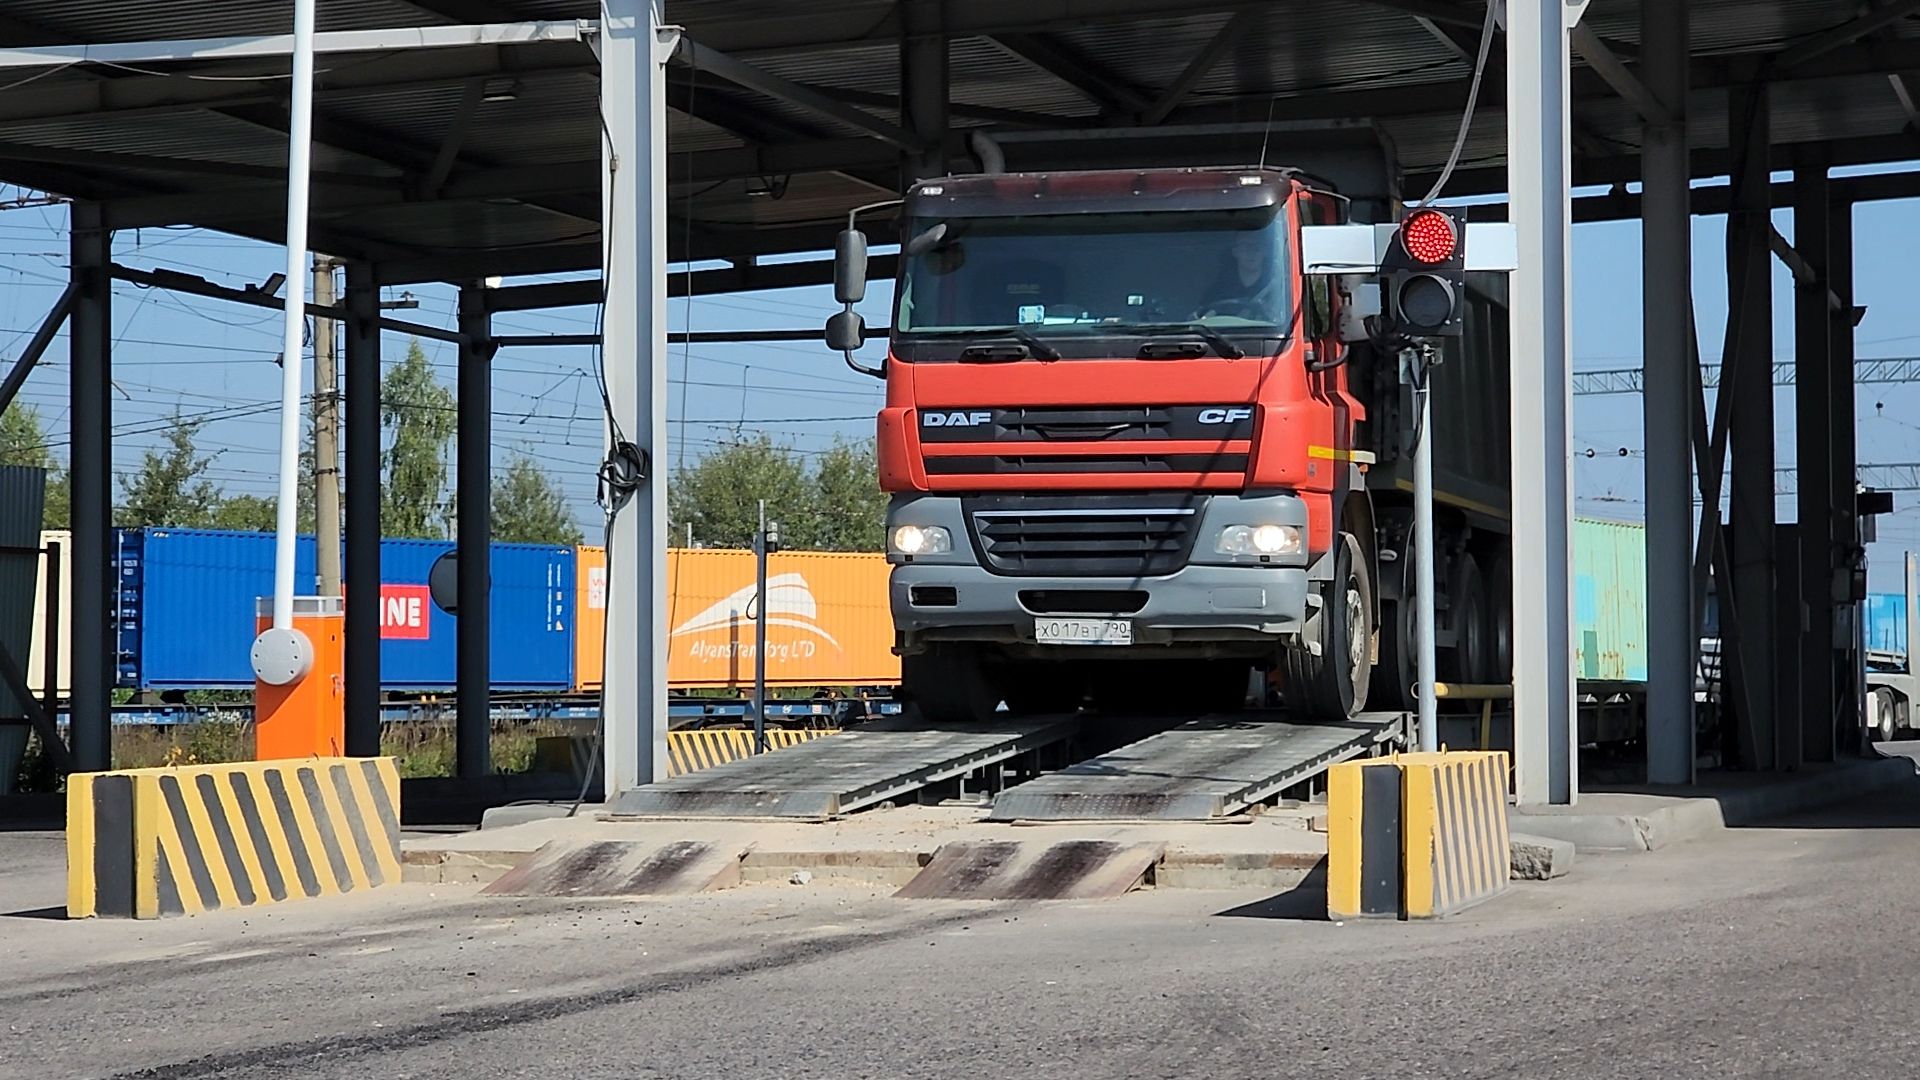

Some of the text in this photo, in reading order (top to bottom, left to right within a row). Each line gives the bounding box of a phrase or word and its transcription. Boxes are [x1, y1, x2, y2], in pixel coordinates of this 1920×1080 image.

[922, 411, 992, 428] DAF
[1197, 408, 1252, 424] CF
[380, 596, 422, 627] INE
[1103, 622, 1127, 635] 790
[690, 639, 816, 663] AlyansTranTorg LTD
